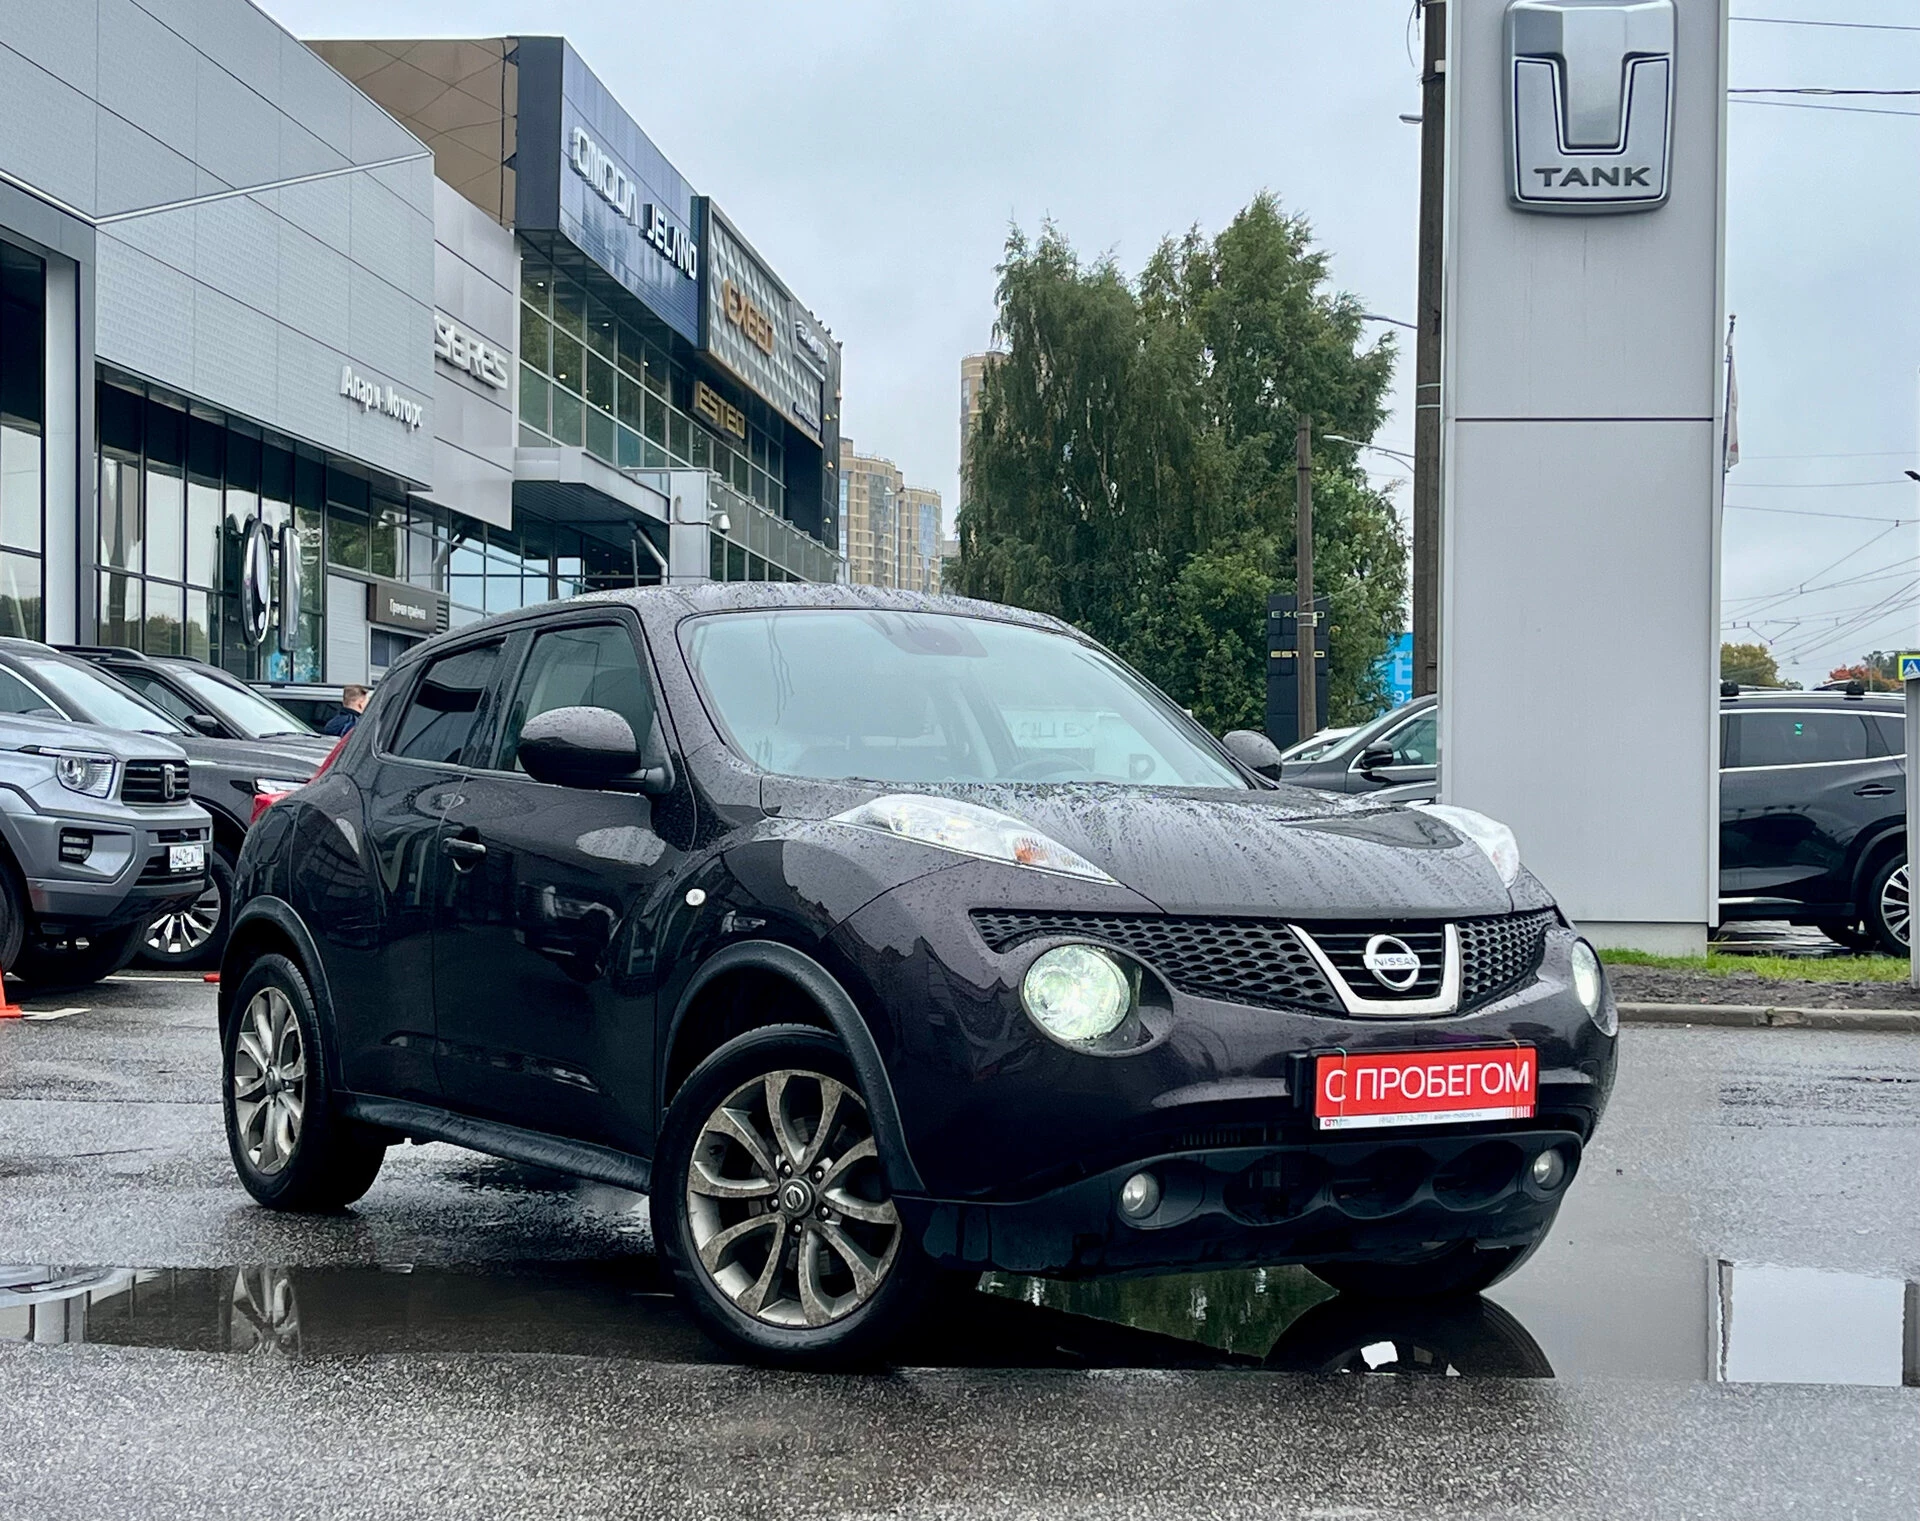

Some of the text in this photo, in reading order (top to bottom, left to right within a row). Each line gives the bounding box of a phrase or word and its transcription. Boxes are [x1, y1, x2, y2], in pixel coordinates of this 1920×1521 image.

[1533, 166, 1651, 187] TANK
[646, 203, 697, 280] JELAND
[435, 315, 508, 390] SERES
[1373, 957, 1418, 967] NISSAN
[1325, 1060, 1530, 1102] С ПРОБЕГОМ
